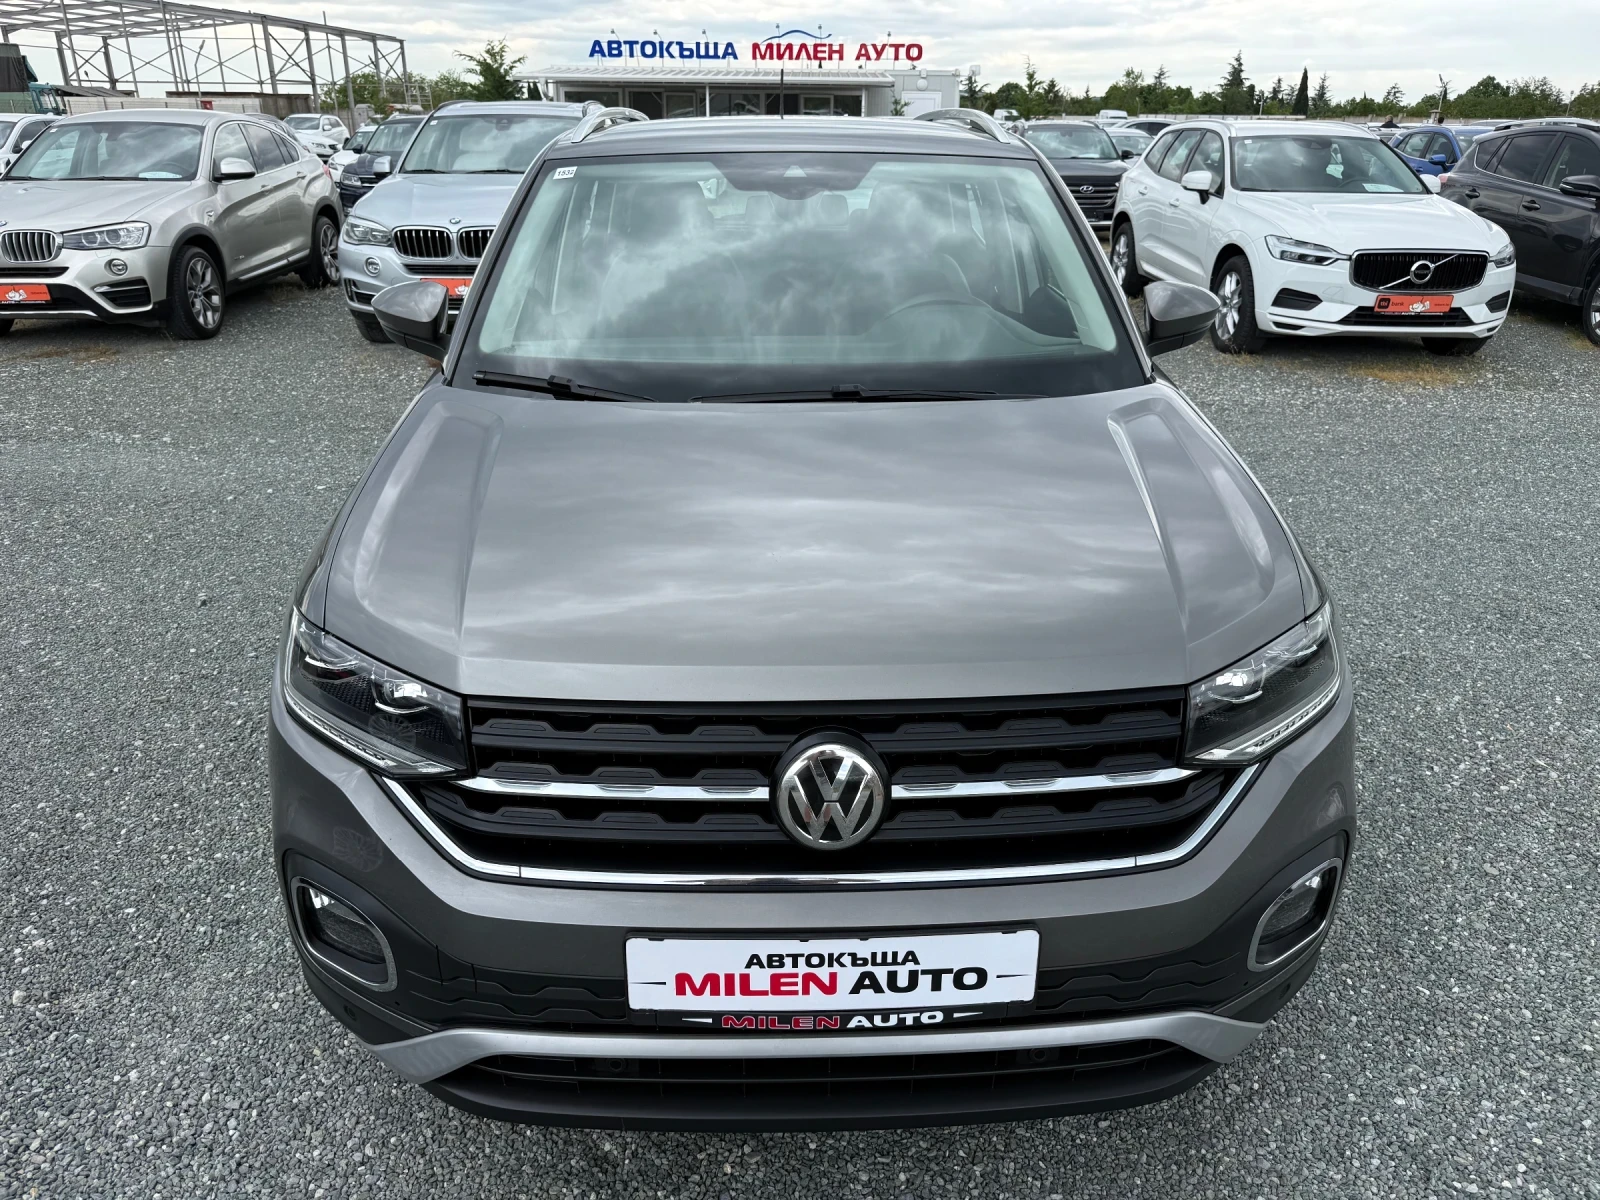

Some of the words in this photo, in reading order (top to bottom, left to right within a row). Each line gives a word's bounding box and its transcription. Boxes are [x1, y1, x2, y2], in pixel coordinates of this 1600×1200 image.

[589, 40, 738, 60] АВТОКЪЩА
[752, 42, 844, 61] МИЛЕН
[855, 43, 923, 61] АУТО
[745, 950, 920, 969] АВТОКЪЩА
[675, 972, 838, 997] MILEN
[848, 966, 988, 994] AUTO
[721, 1015, 840, 1029] MILEN
[846, 1010, 944, 1028] AUTO
